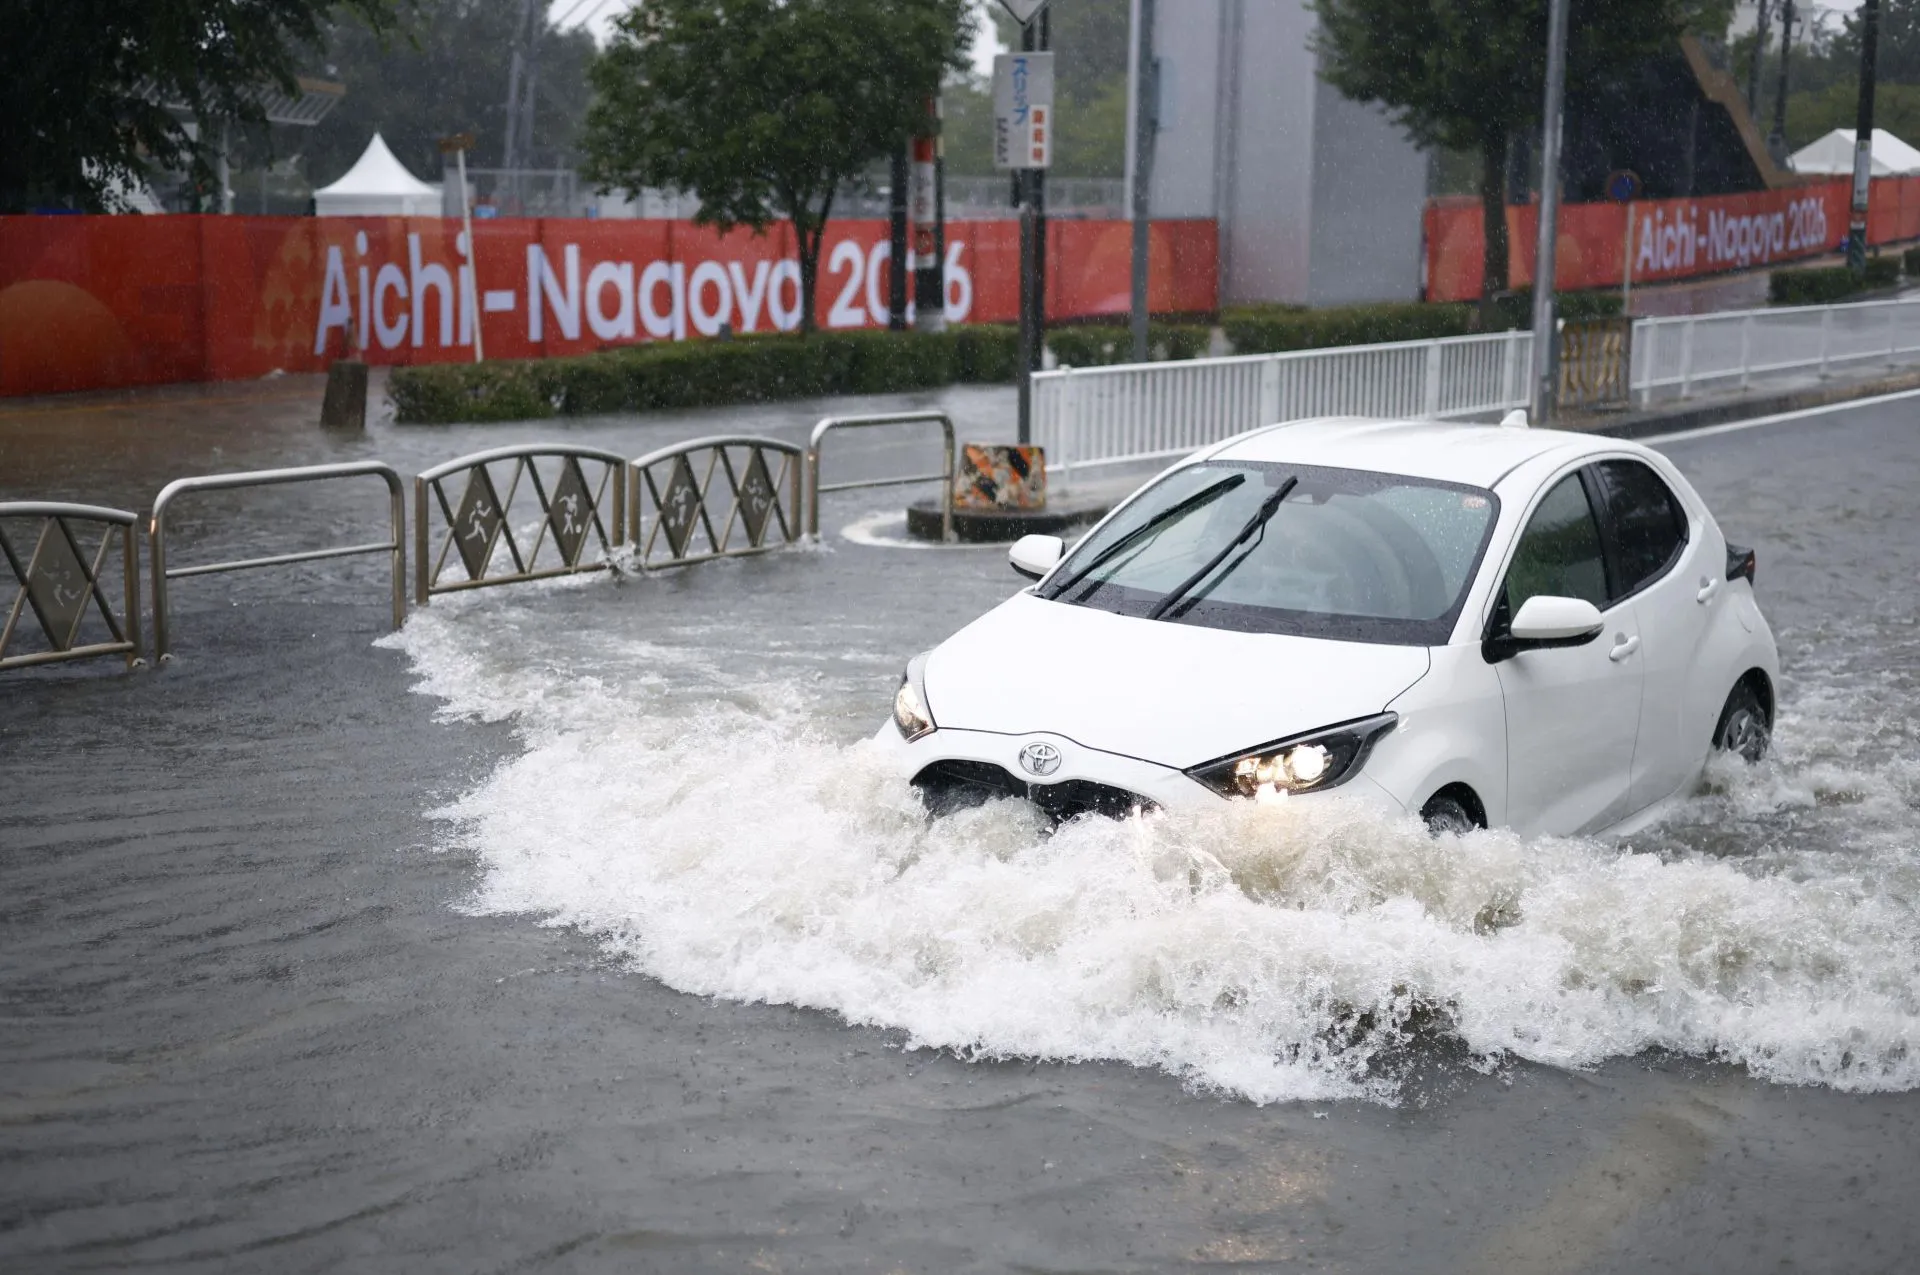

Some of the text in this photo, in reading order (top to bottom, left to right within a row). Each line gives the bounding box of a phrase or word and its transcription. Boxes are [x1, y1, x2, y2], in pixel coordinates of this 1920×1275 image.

[1636, 197, 1827, 271] Aichi-Nagoya 2026
[827, 239, 972, 327] 206
